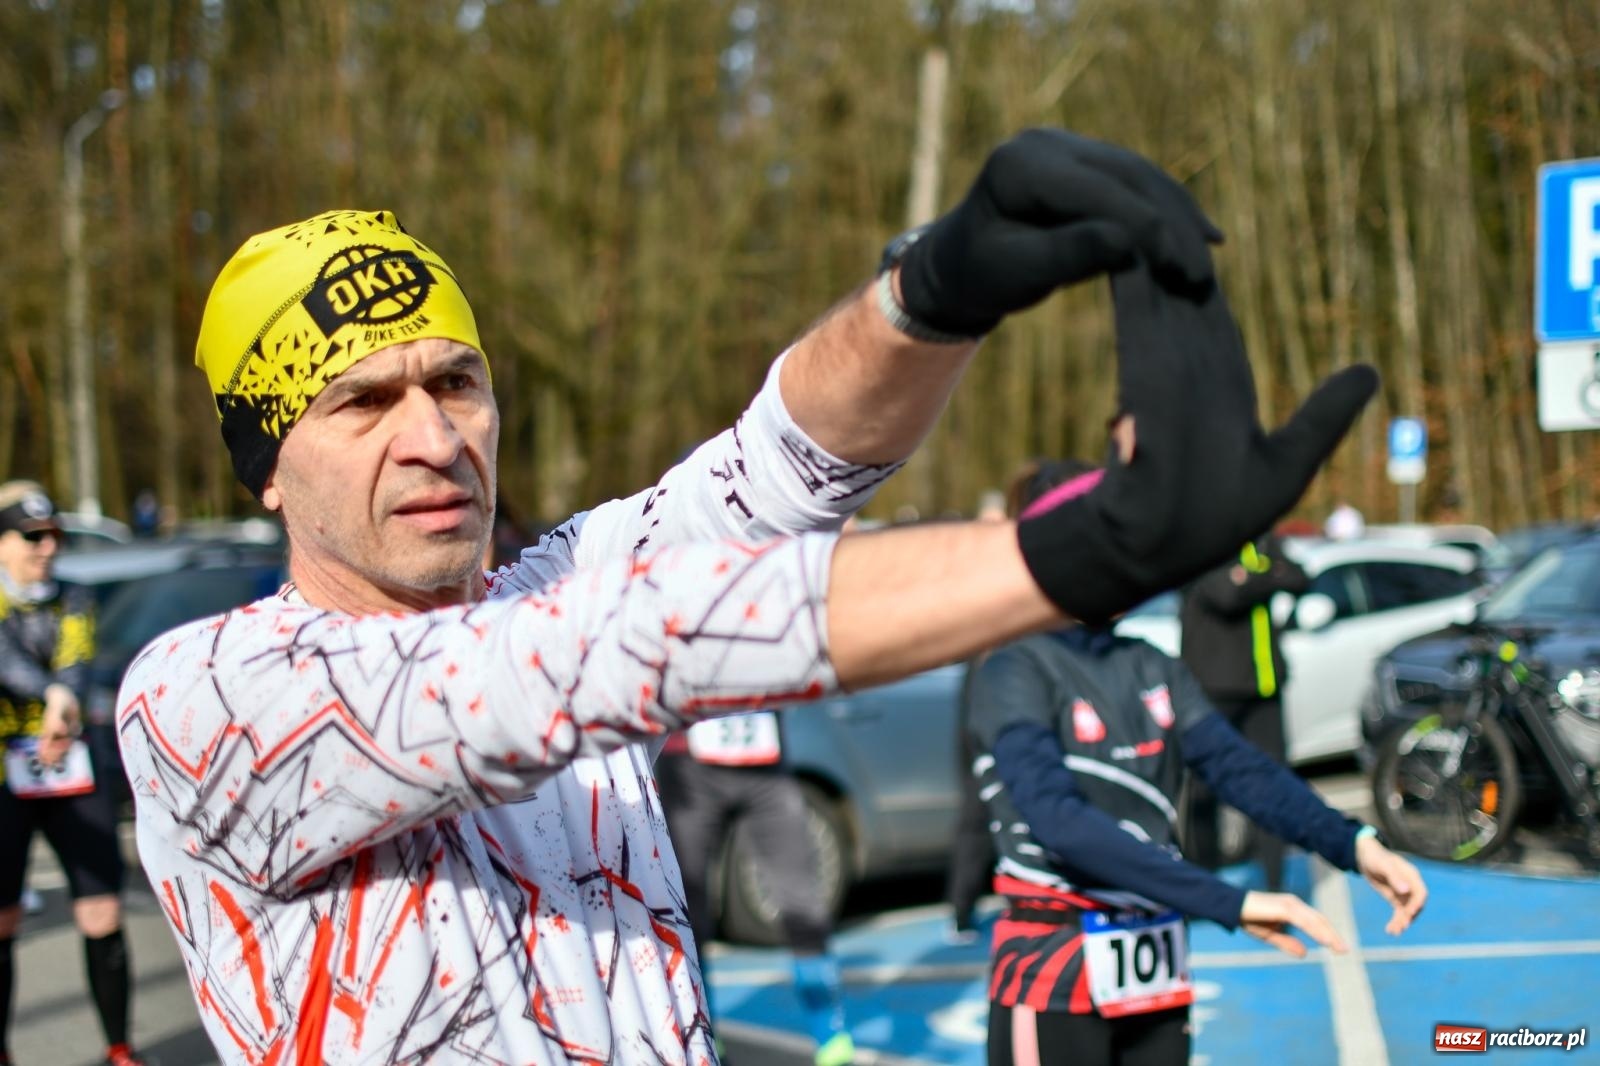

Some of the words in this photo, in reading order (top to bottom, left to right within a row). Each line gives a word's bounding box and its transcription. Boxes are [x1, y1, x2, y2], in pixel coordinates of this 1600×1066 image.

[326, 258, 416, 315] OKR
[363, 327, 397, 342] BIKE
[1110, 930, 1174, 988] 101
